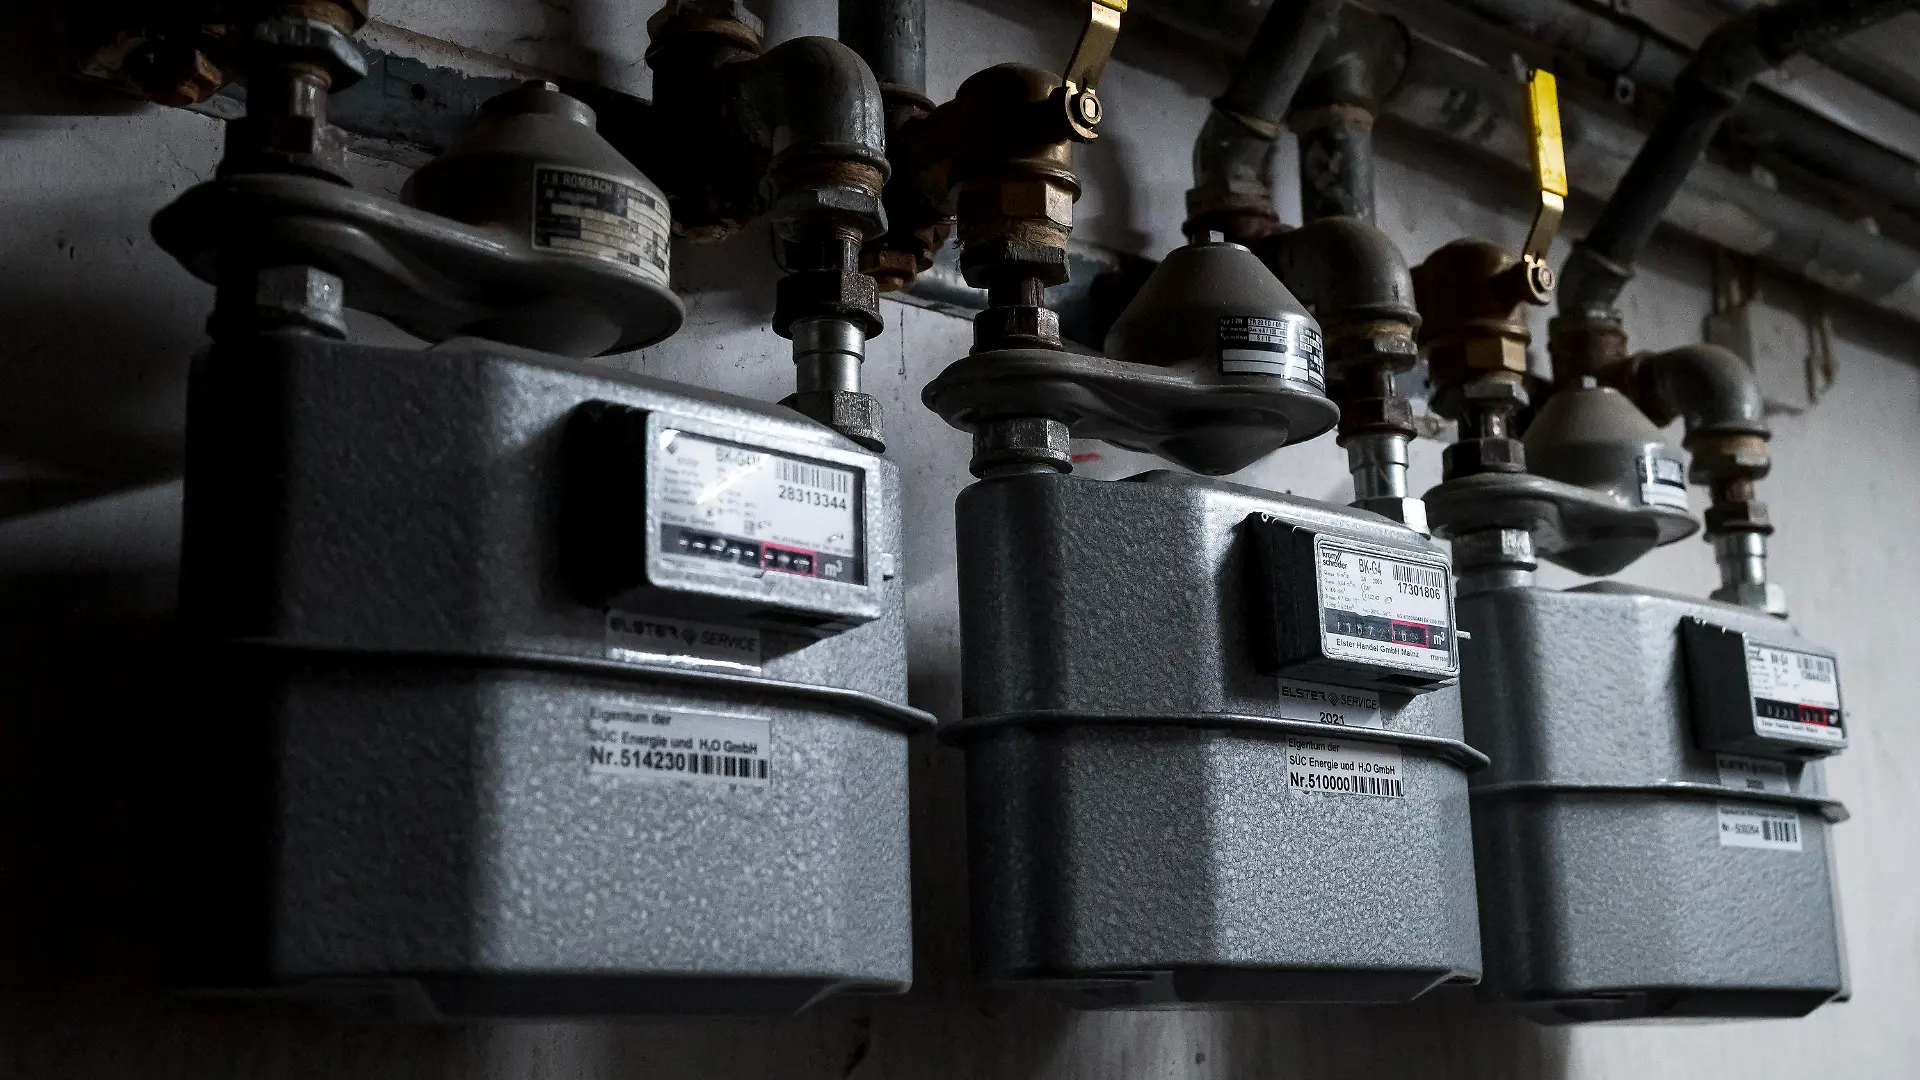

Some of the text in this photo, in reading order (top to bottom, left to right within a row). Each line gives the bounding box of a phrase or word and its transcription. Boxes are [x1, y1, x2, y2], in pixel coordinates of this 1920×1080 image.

[778, 485, 847, 511] 28313344
[1397, 581, 1441, 600] 17301806
[1336, 638, 1356, 648] Elster
[1356, 641, 1379, 652] Handel
[1380, 645, 1400, 655] GmbH
[1281, 685, 1377, 709] ELSTER SERVICE
[1320, 711, 1345, 725] 2021
[723, 739, 758, 754] GmbH
[1288, 737, 1340, 752] Eigentum der
[1289, 753, 1307, 766] SÜC
[1309, 757, 1339, 770] Energie
[1340, 761, 1355, 771] und
[1373, 763, 1396, 775] GmbH
